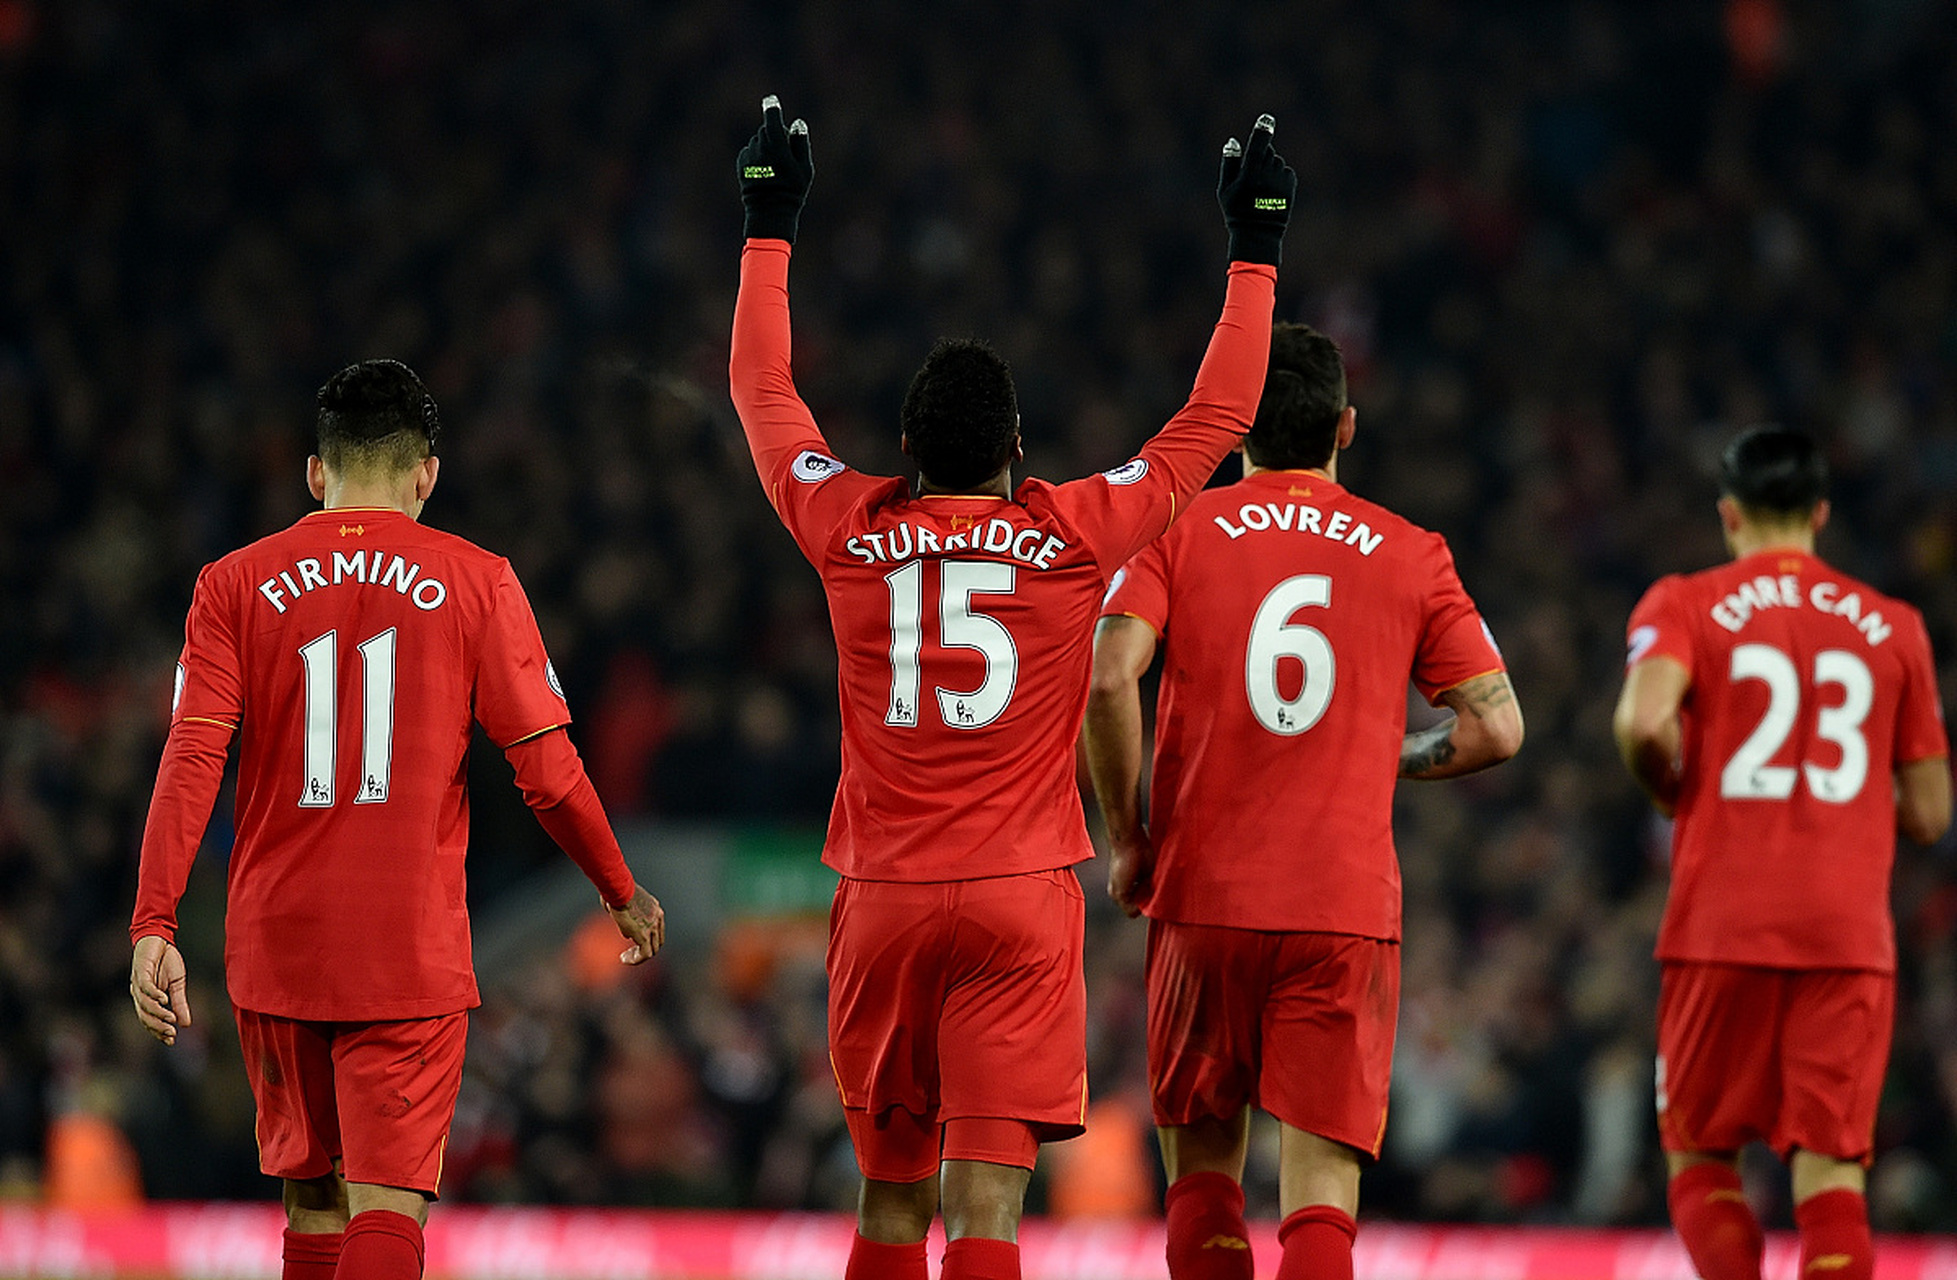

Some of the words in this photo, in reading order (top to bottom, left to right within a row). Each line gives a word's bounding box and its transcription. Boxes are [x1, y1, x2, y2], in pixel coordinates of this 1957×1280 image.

[257, 549, 447, 614] FIRMINO
[846, 518, 1066, 570] STURRIDGE
[1213, 502, 1385, 557] LOVREN
[884, 558, 1018, 730] 15
[1245, 573, 1336, 737] 6
[1710, 574, 1803, 633] EMRE
[1809, 582, 1893, 646] CAN
[297, 626, 398, 808] 11
[1720, 642, 1874, 804] 23
